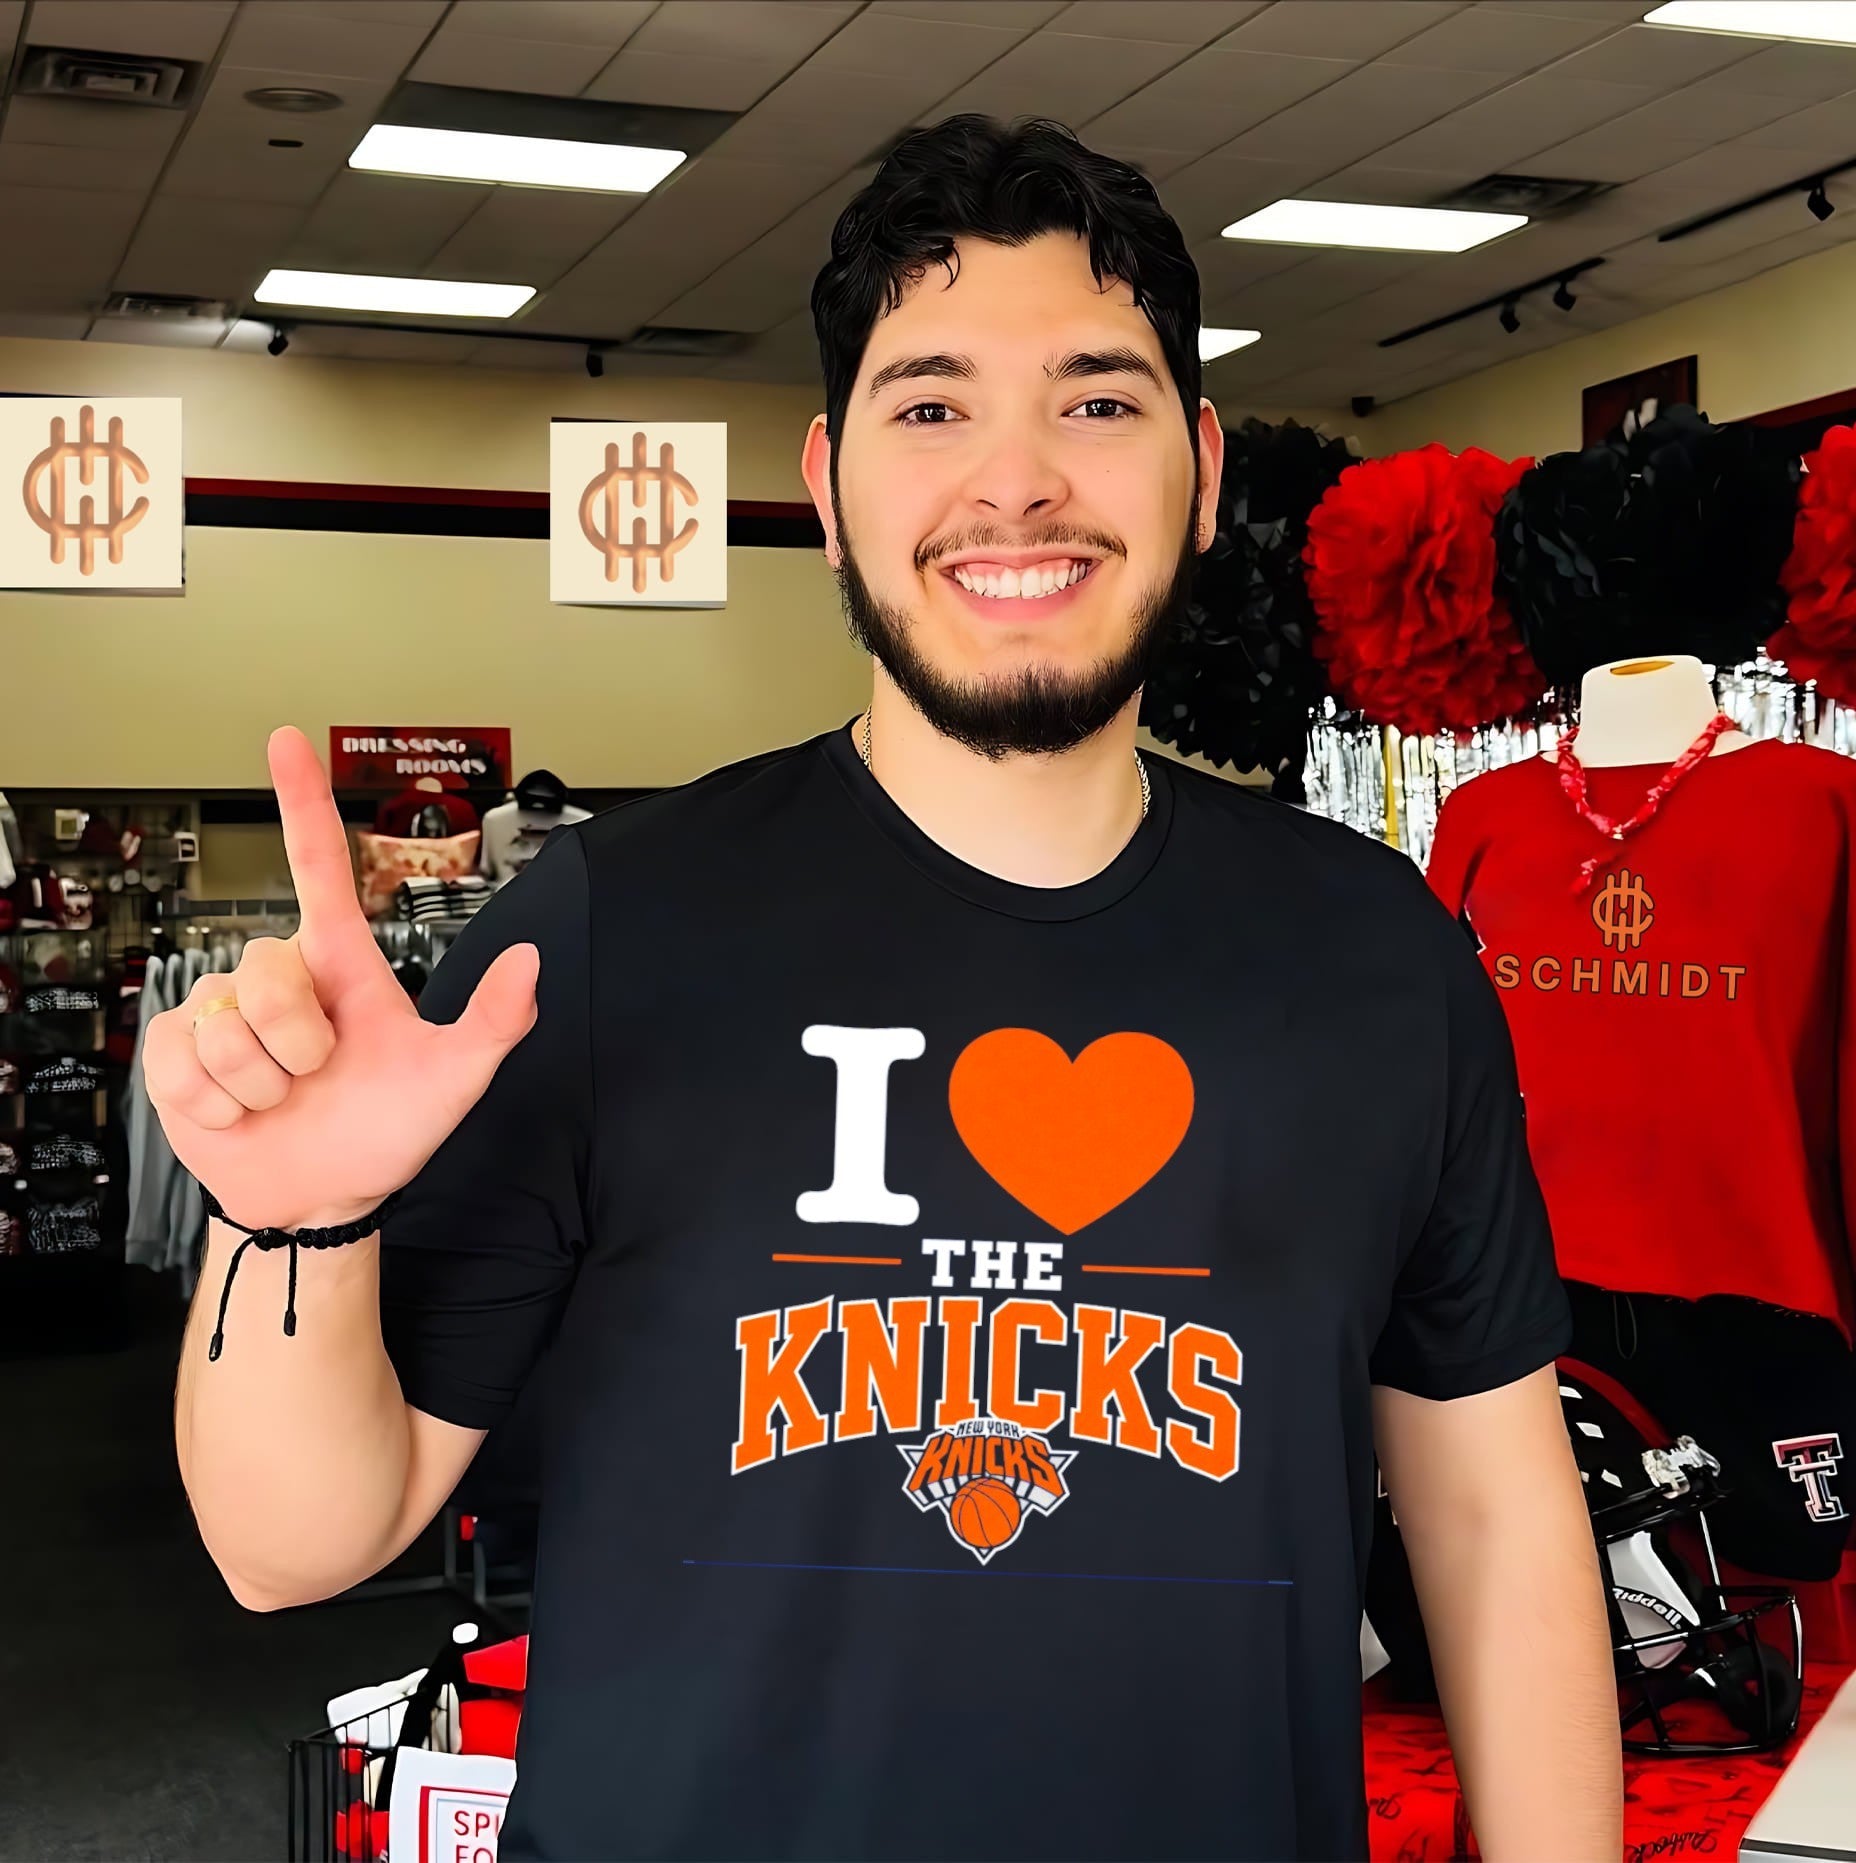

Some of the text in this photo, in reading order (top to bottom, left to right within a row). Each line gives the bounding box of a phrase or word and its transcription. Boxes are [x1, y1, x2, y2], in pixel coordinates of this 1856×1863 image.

[342, 737, 467, 754] DRESSING
[396, 758, 487, 775] ROOMS
[1493, 953, 1747, 1000] SCHMIDT
[795, 1024, 926, 1226] I
[922, 1238, 1064, 1291] THE
[731, 1294, 1243, 1482] KNICKS
[956, 1421, 1020, 1438] NEW YORK
[908, 1432, 1065, 1498] KNICKS
